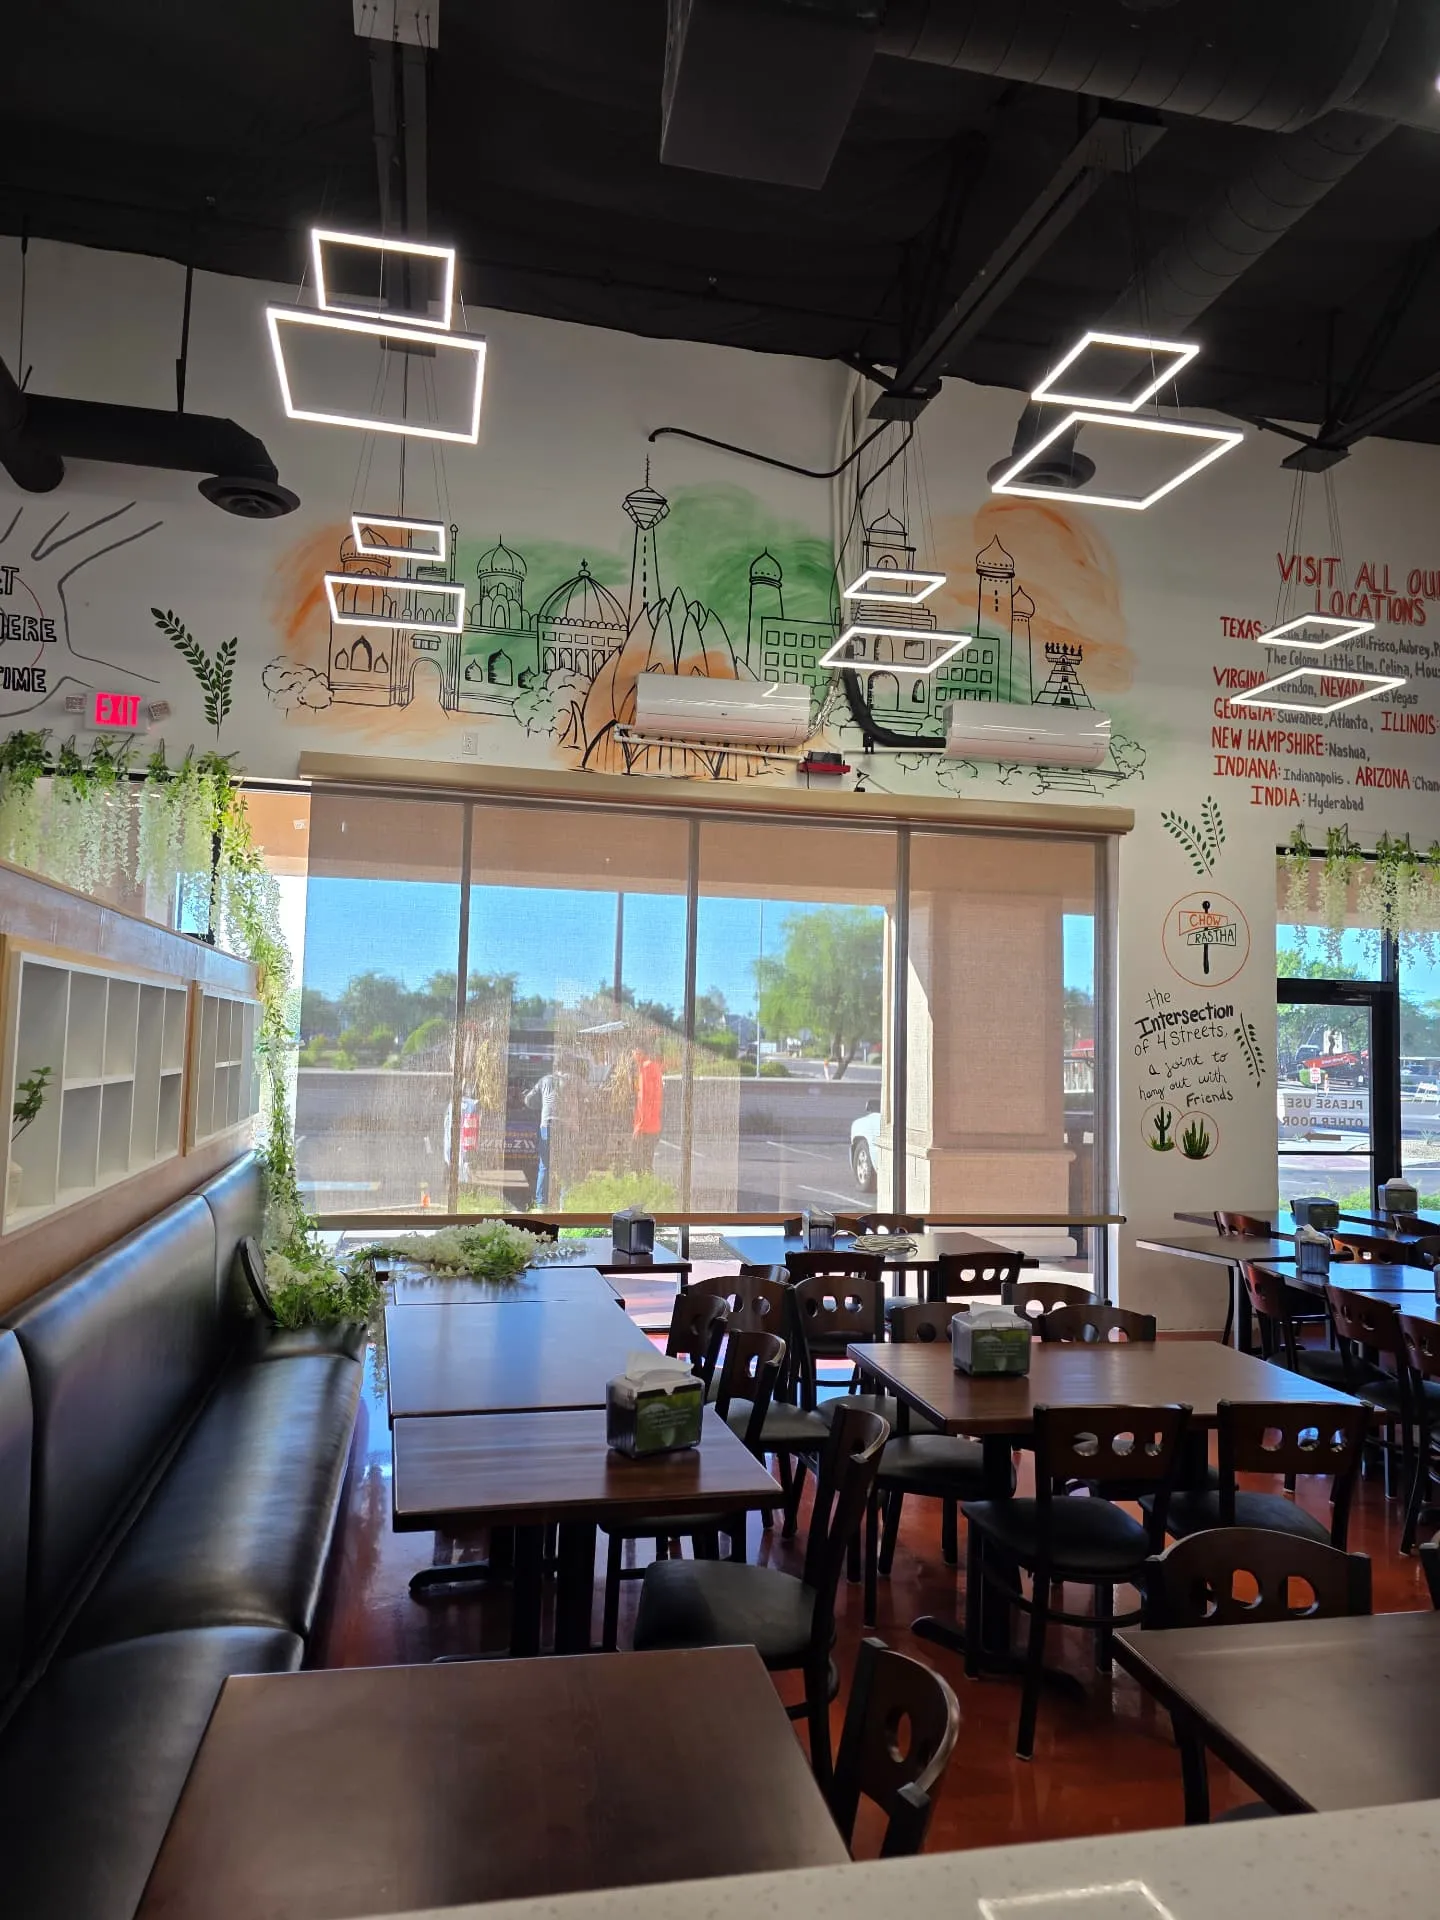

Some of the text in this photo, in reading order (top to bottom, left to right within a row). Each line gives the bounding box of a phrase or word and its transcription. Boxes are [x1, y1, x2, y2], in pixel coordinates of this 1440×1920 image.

[0, 566, 19, 595] T
[1277, 553, 1341, 588] VISIT
[1355, 562, 1397, 594] ALL
[1315, 589, 1426, 626] LOCATIONS
[1265, 647, 1287, 665] The
[0, 666, 46, 692] IME
[95, 692, 141, 727] EXIT
[1390, 689, 1418, 708] Vegas
[1328, 710, 1374, 733] Atlanta,
[1211, 726, 1370, 762] NEW HAMPSHIRE: Nashua,
[1213, 755, 1281, 779] INDIANA:
[1414, 776, 1440, 792] Chan
[1308, 793, 1364, 815] Hyderabad
[1189, 913, 1221, 928] CHOW
[1195, 928, 1235, 944] RASTHA
[1145, 989, 1171, 1009] the
[1134, 1002, 1234, 1039] Intersection
[1134, 1038, 1149, 1056] of
[1157, 1031, 1167, 1050] 4
[1164, 1053, 1203, 1078] joint
[1212, 1051, 1228, 1063] to
[1138, 1066, 1228, 1101] hang out with
[1186, 1087, 1234, 1108] Friends
